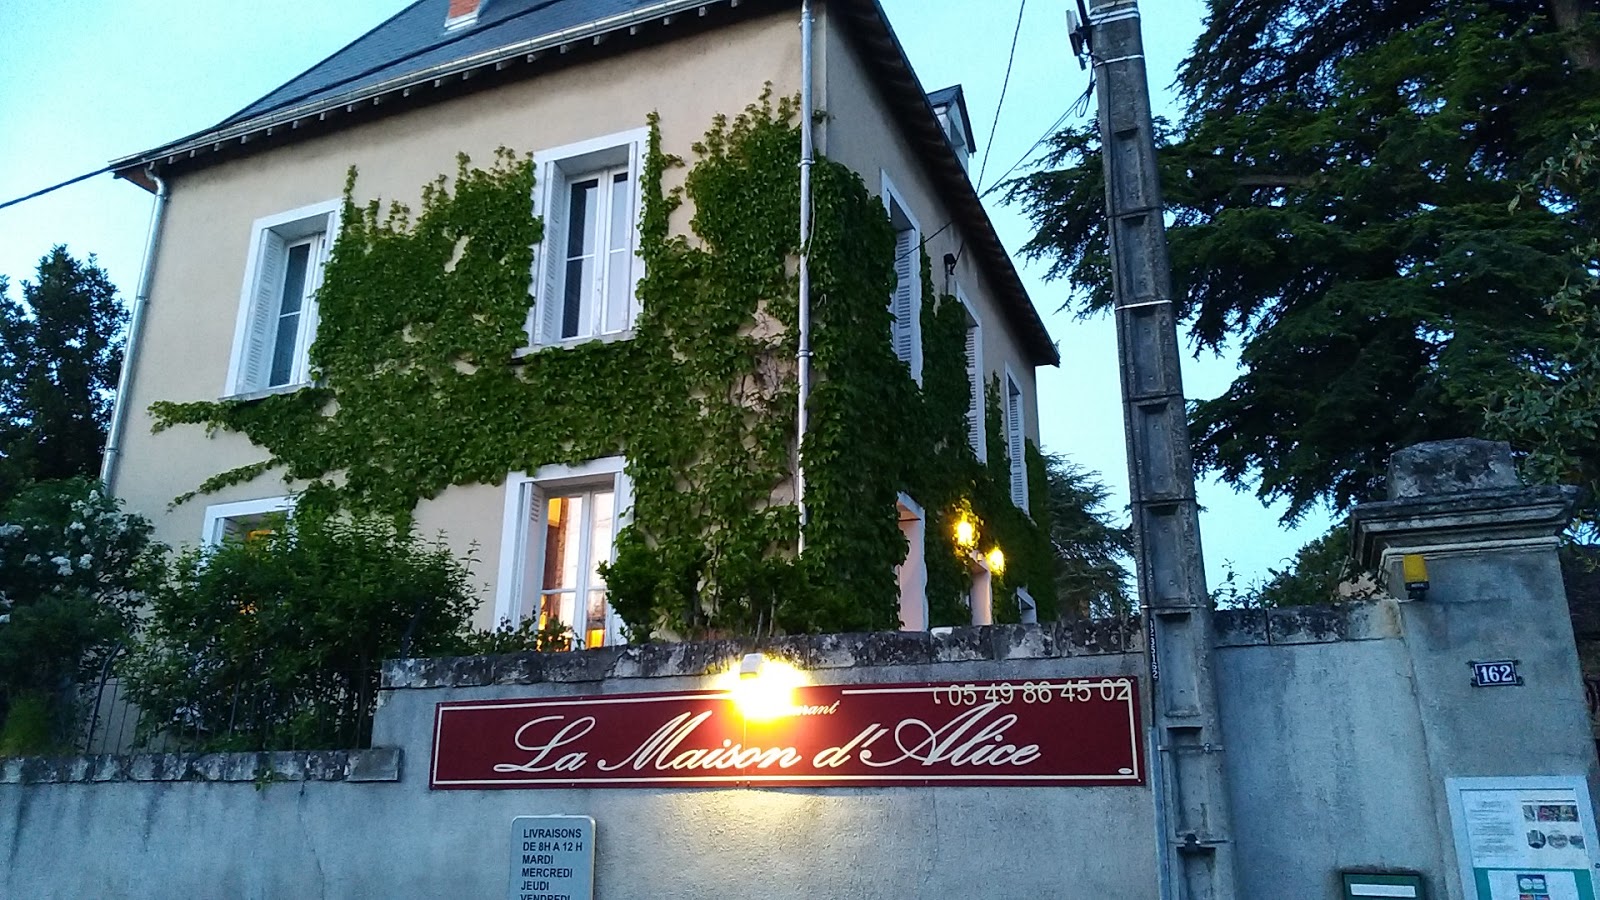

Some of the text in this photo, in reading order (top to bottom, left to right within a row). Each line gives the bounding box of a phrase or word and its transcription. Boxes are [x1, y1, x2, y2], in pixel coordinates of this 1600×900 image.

[1481, 665, 1512, 682] 162
[948, 677, 1130, 706] 05 49 86 45 02
[493, 701, 1042, 773] La Maison d'Alice
[523, 828, 582, 838] LIVRAISONS
[522, 841, 583, 851] DE 8H A 12 H
[522, 855, 554, 865] MARDI
[521, 868, 573, 878] MERCREDI
[520, 881, 550, 891] JEUDI
